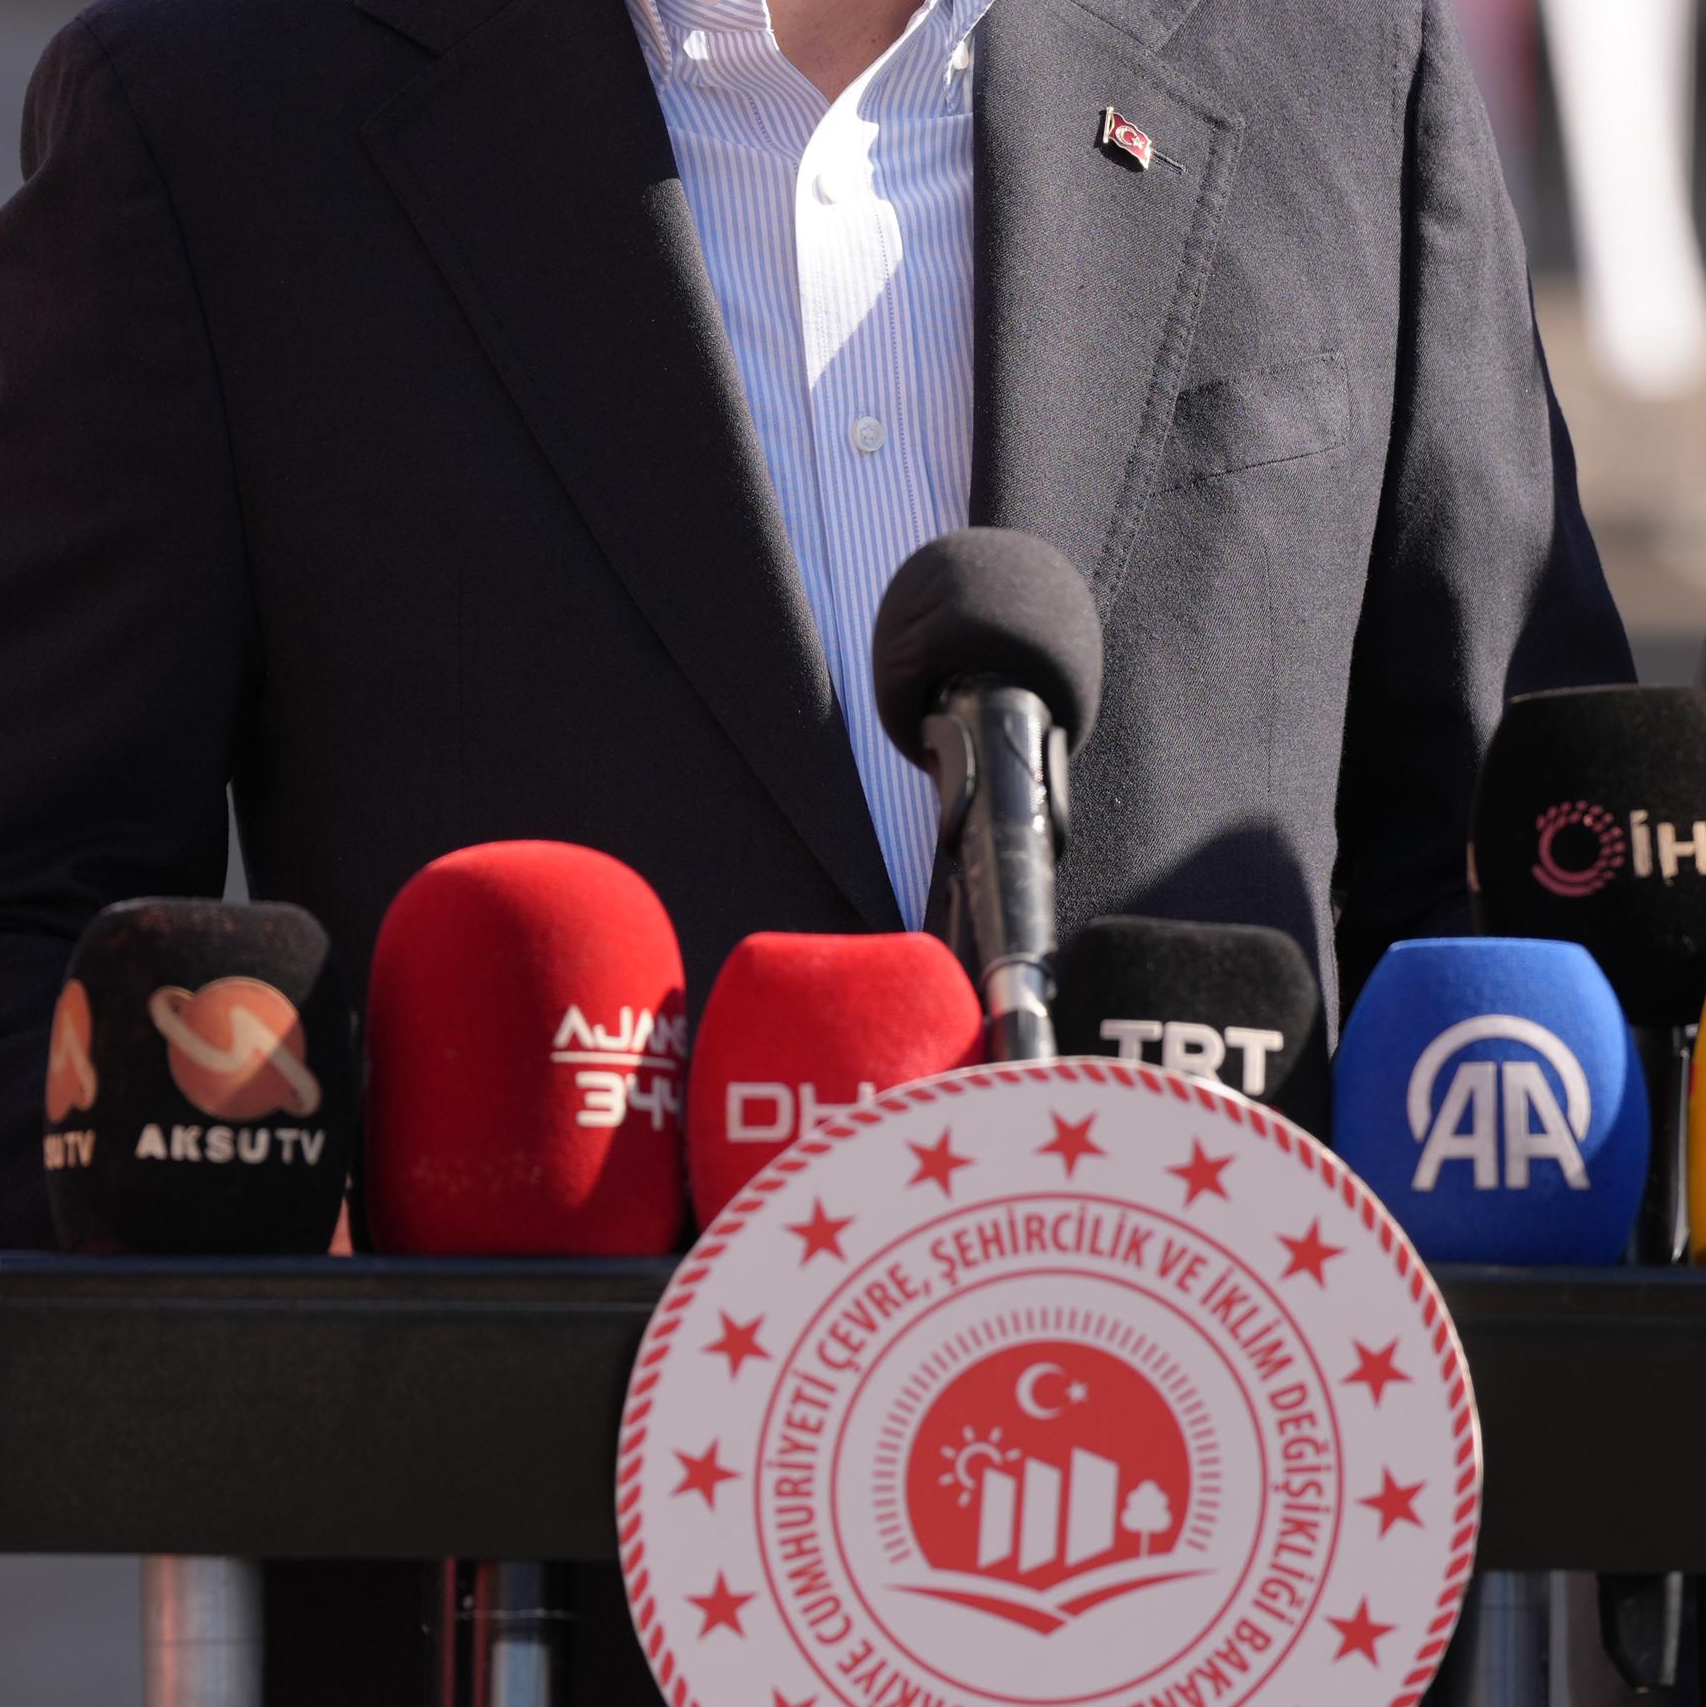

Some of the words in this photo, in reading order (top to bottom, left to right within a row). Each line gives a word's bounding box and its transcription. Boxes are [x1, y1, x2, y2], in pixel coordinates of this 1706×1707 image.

[1101, 1019, 1284, 1096] TRT
[1410, 1061, 1591, 1191] AA
[765, 1368, 853, 1645] CUMHURİYETİ
[816, 1261, 932, 1373] ÇEVRE,
[929, 1201, 1154, 1286] ŞEHİRCİLİK
[1157, 1237, 1209, 1294] VE
[1199, 1263, 1294, 1382] İKLİM
[1250, 1381, 1332, 1627] DEĞİŞİKLİĞİ
